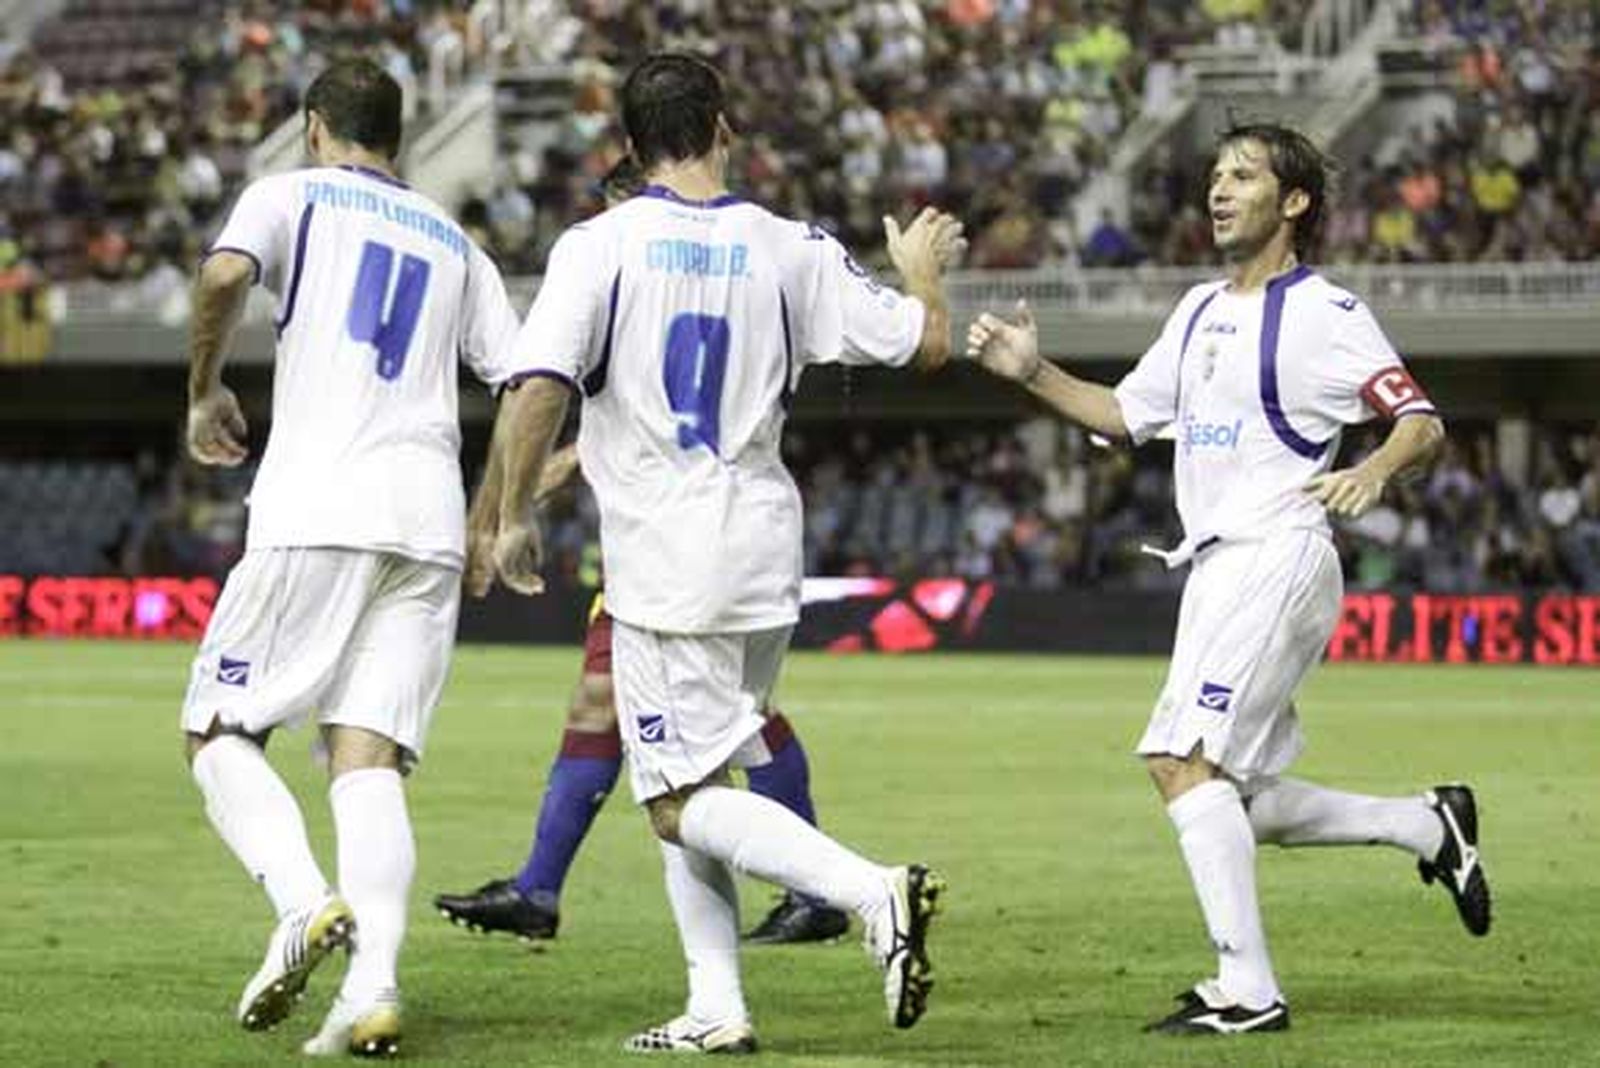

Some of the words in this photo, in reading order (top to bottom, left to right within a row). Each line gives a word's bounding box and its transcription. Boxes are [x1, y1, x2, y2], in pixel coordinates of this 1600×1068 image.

[346, 239, 431, 382] 4
[662, 311, 731, 456] 9
[1372, 371, 1413, 407] C
[1327, 593, 1523, 664] ELITE
